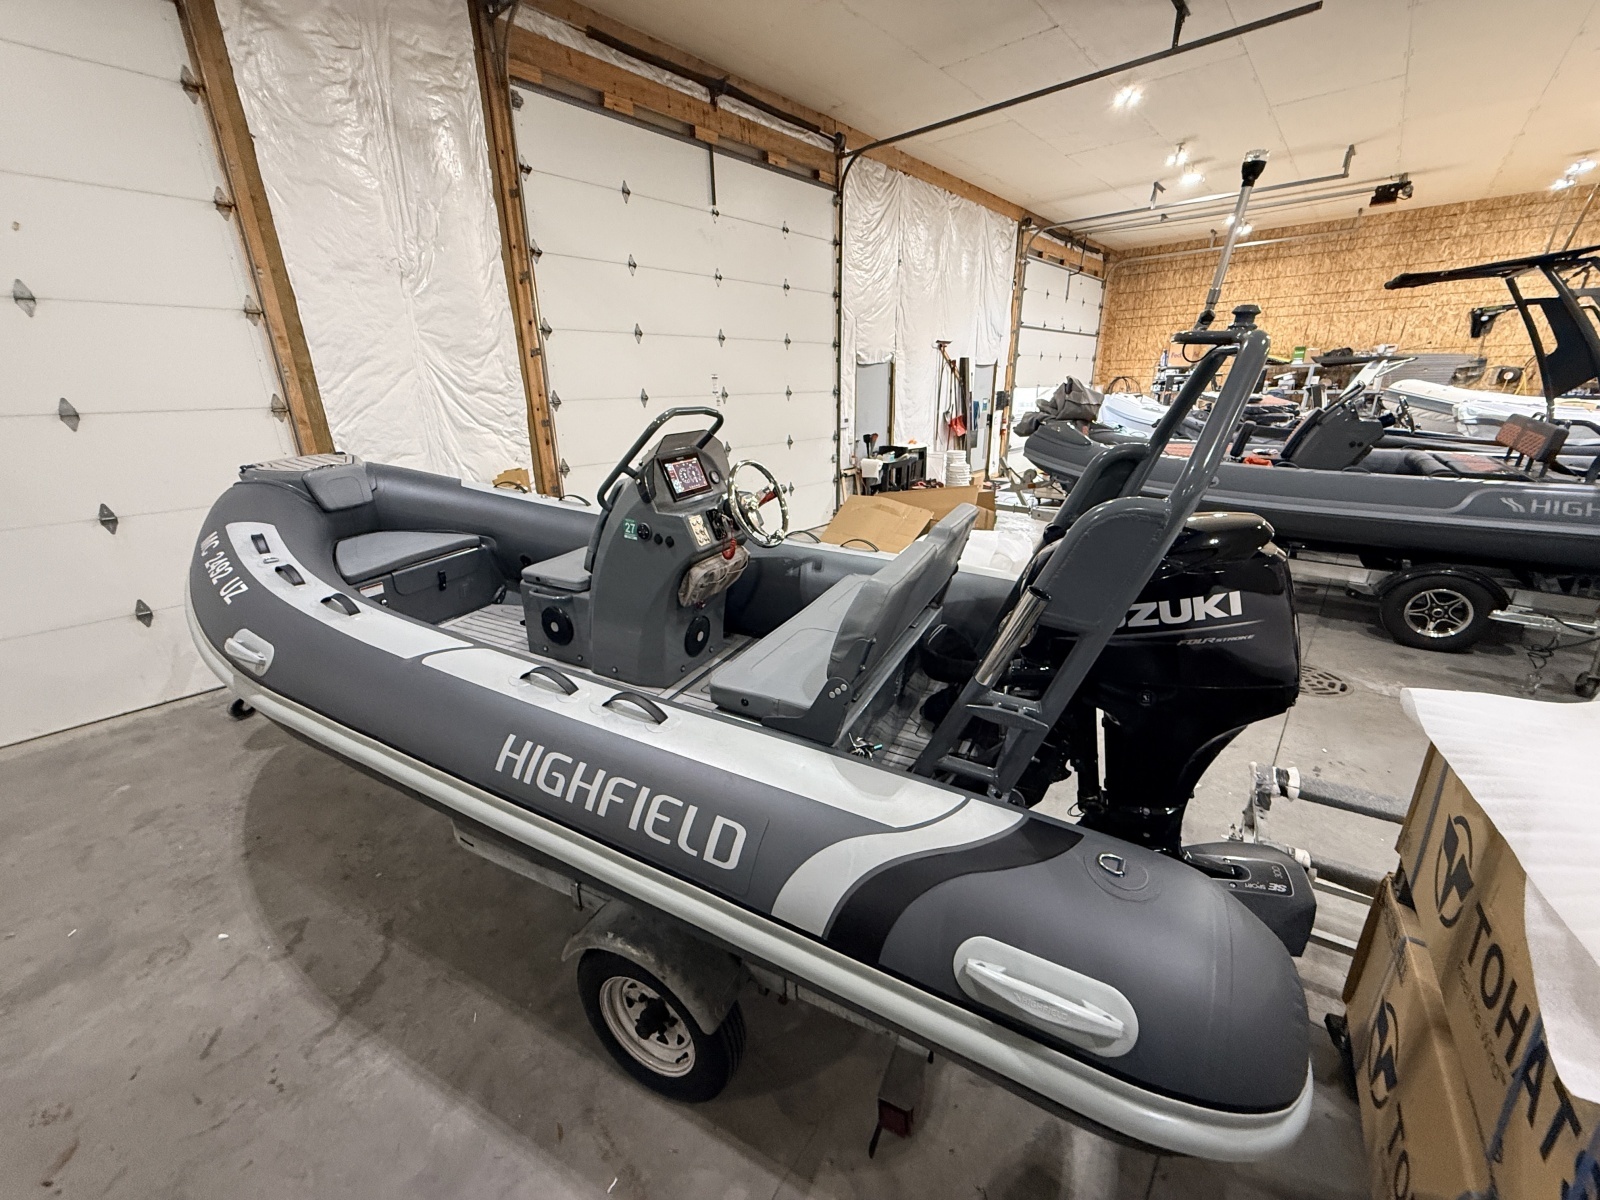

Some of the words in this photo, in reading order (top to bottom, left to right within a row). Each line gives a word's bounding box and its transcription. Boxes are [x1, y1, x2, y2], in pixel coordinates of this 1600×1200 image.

[624, 522, 636, 534] 27
[204, 551, 234, 585] 2492
[219, 576, 249, 605] UZ
[1117, 590, 1243, 628] ZUKI
[494, 733, 747, 870] HIGHFIELD
[1267, 882, 1288, 893] SE
[1387, 1102, 1414, 1200] TO
